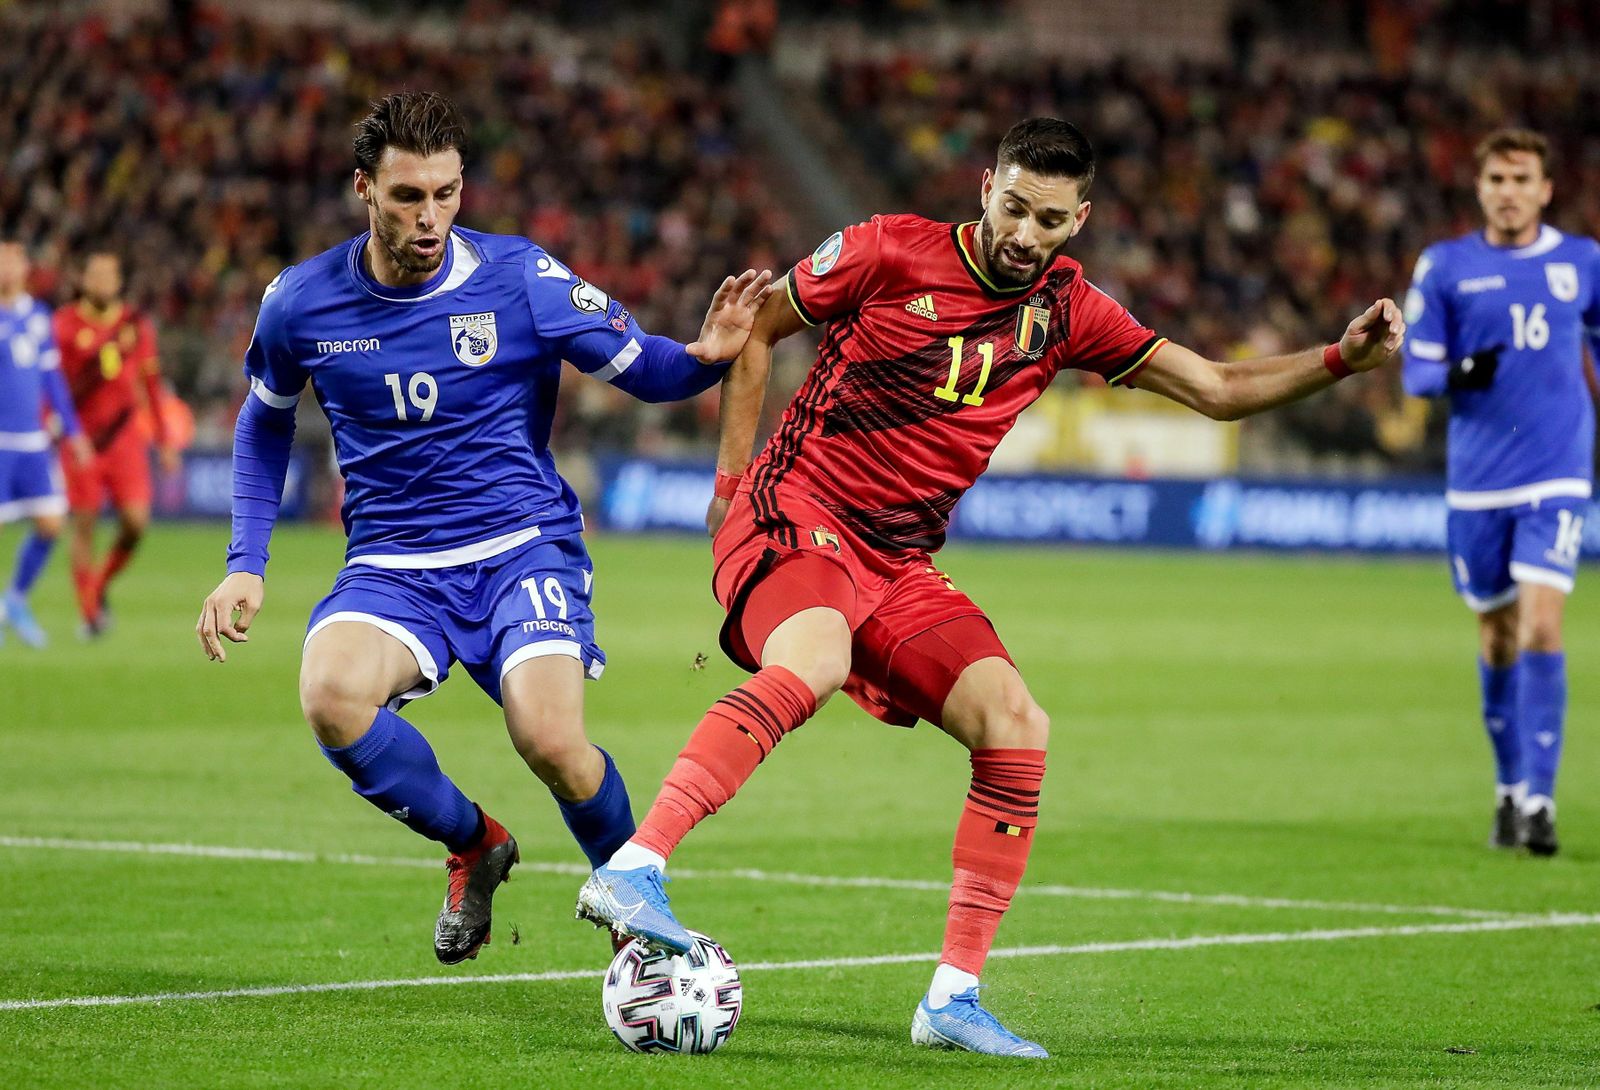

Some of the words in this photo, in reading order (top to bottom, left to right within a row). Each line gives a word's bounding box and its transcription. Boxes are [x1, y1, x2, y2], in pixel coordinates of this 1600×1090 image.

[905, 303, 938, 322] adidas
[1509, 303, 1550, 351] 16
[317, 338, 380, 354] macron
[933, 335, 994, 407] 11
[384, 372, 439, 422] 19
[520, 577, 568, 620] 19
